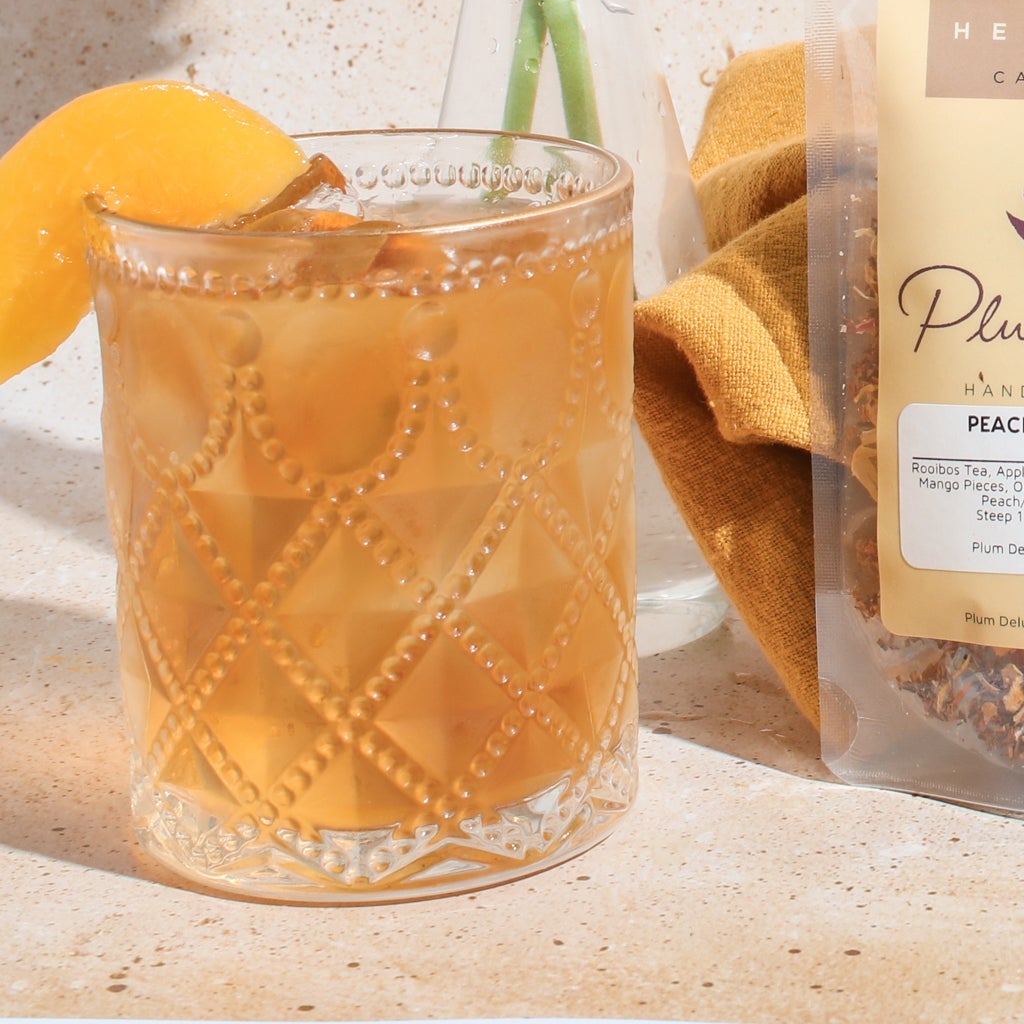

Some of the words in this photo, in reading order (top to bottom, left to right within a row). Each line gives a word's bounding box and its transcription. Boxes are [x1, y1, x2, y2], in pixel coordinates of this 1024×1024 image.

[911, 461, 960, 476] Rooibos
[963, 464, 992, 479] Tea,
[918, 476, 960, 493] Mango
[963, 478, 1009, 494] Pieces,
[976, 509, 1013, 525] Steep
[972, 541, 1004, 555] Plum
[964, 611, 995, 626] Plum
